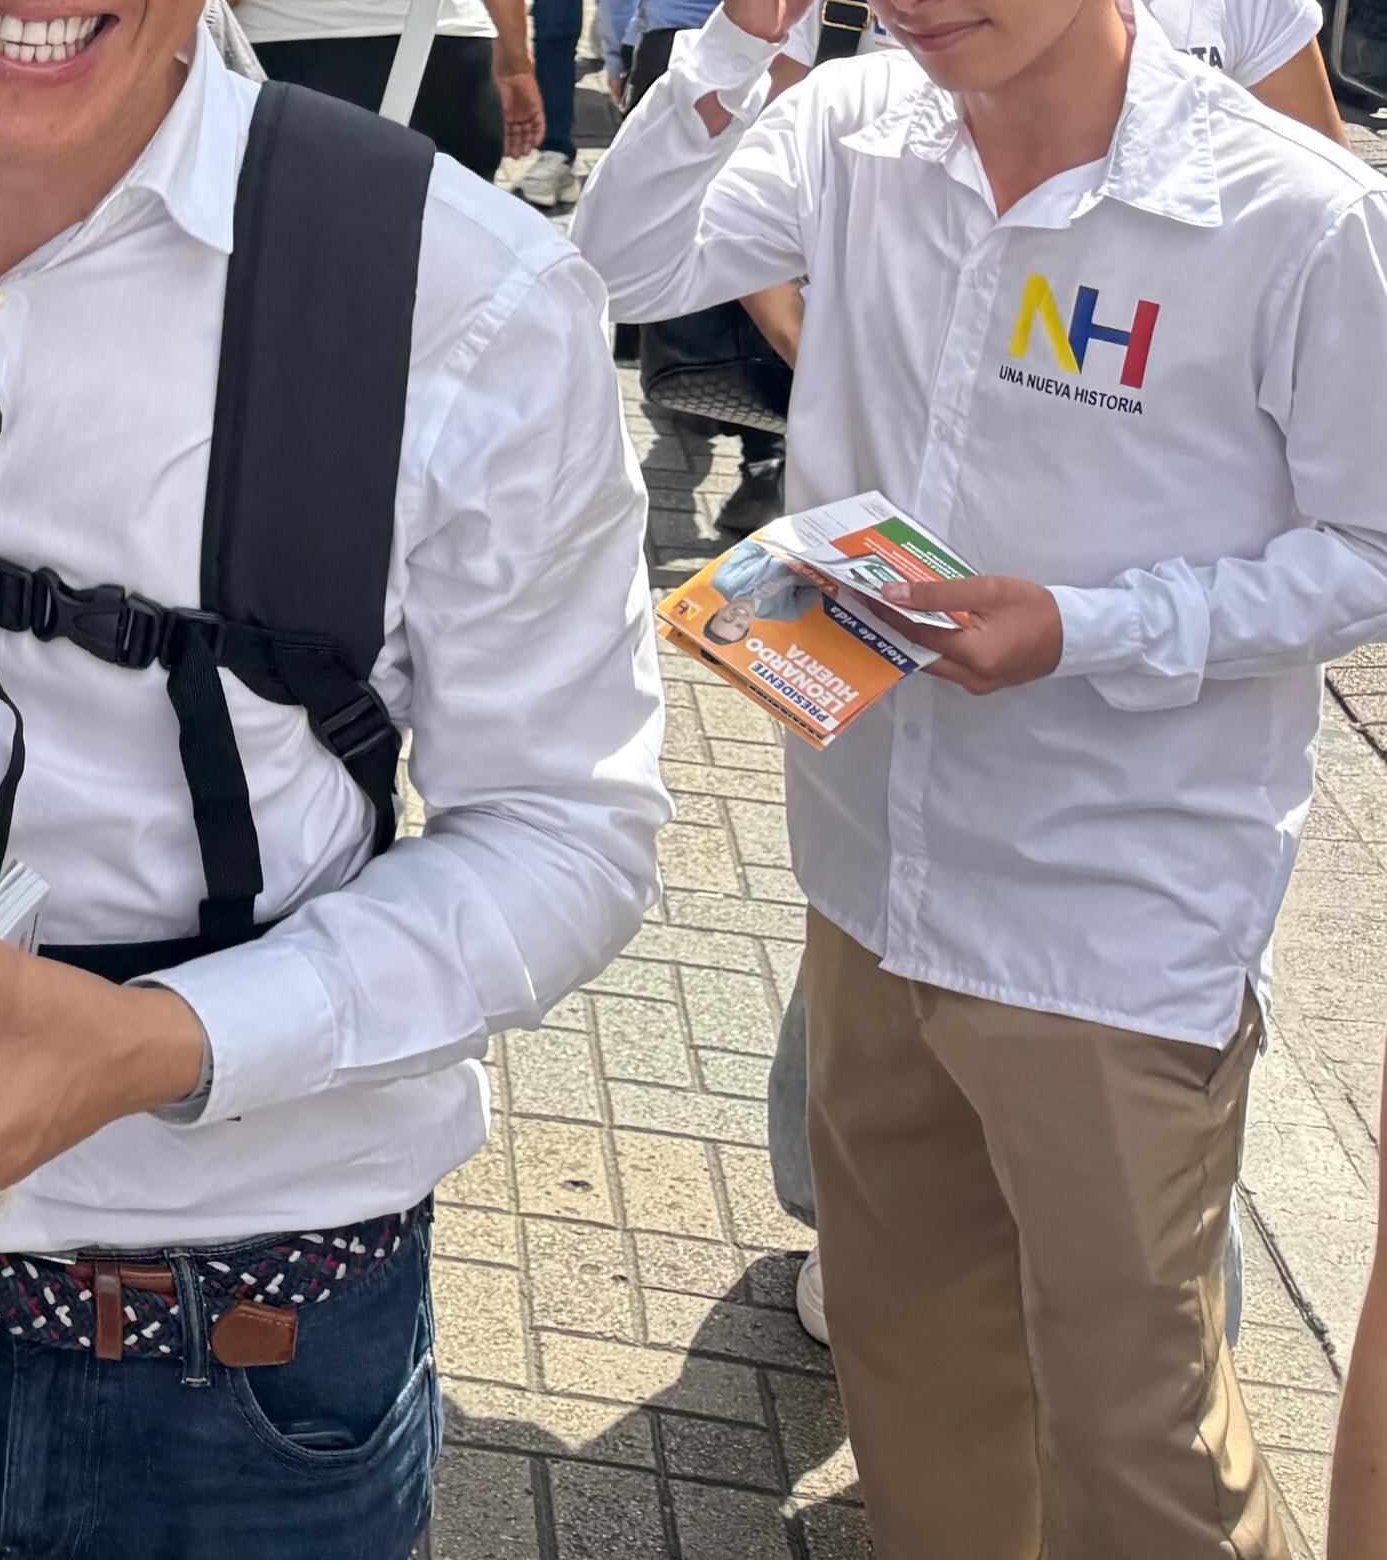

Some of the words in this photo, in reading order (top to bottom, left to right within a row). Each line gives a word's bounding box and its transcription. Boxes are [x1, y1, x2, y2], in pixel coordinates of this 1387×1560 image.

[999, 364, 1024, 386] UNA
[1026, 373, 1071, 400] NUEVA
[1074, 386, 1143, 416] HISTORIA
[829, 605, 857, 629] vida
[858, 626, 877, 642] de
[745, 638, 847, 715] LEONARDO
[784, 643, 860, 703] HUERTA
[876, 641, 909, 667] Hoja
[751, 662, 829, 723] PRESIDENTE
